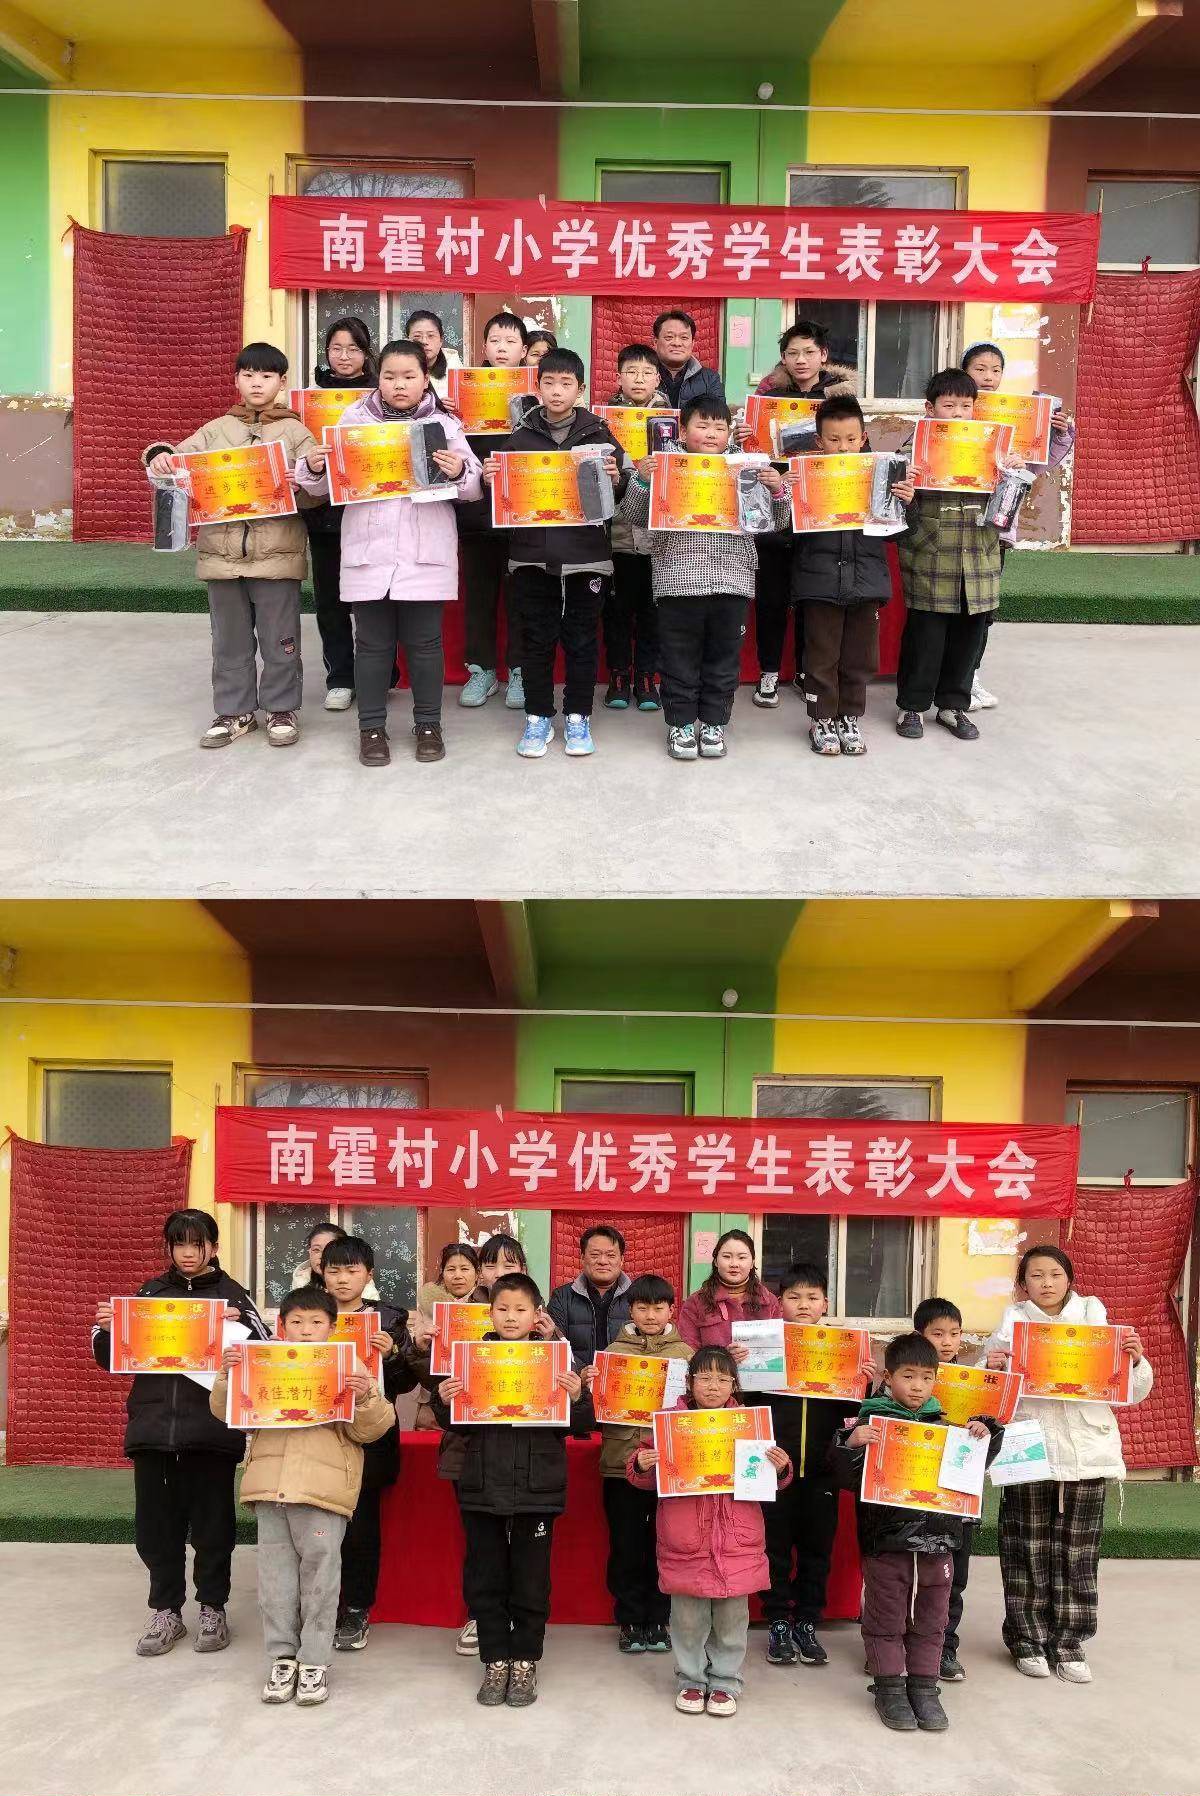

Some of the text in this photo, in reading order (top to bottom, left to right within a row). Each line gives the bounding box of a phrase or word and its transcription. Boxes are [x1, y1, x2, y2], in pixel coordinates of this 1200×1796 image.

[319, 213, 1060, 287] 南霍村小学优秀学生表彰大会
[204, 479, 264, 497] 进步学生
[267, 1124, 1038, 1201] 南霍村小学优秀学生表彰大会
[257, 1384, 331, 1402] 最佳潜力奖
